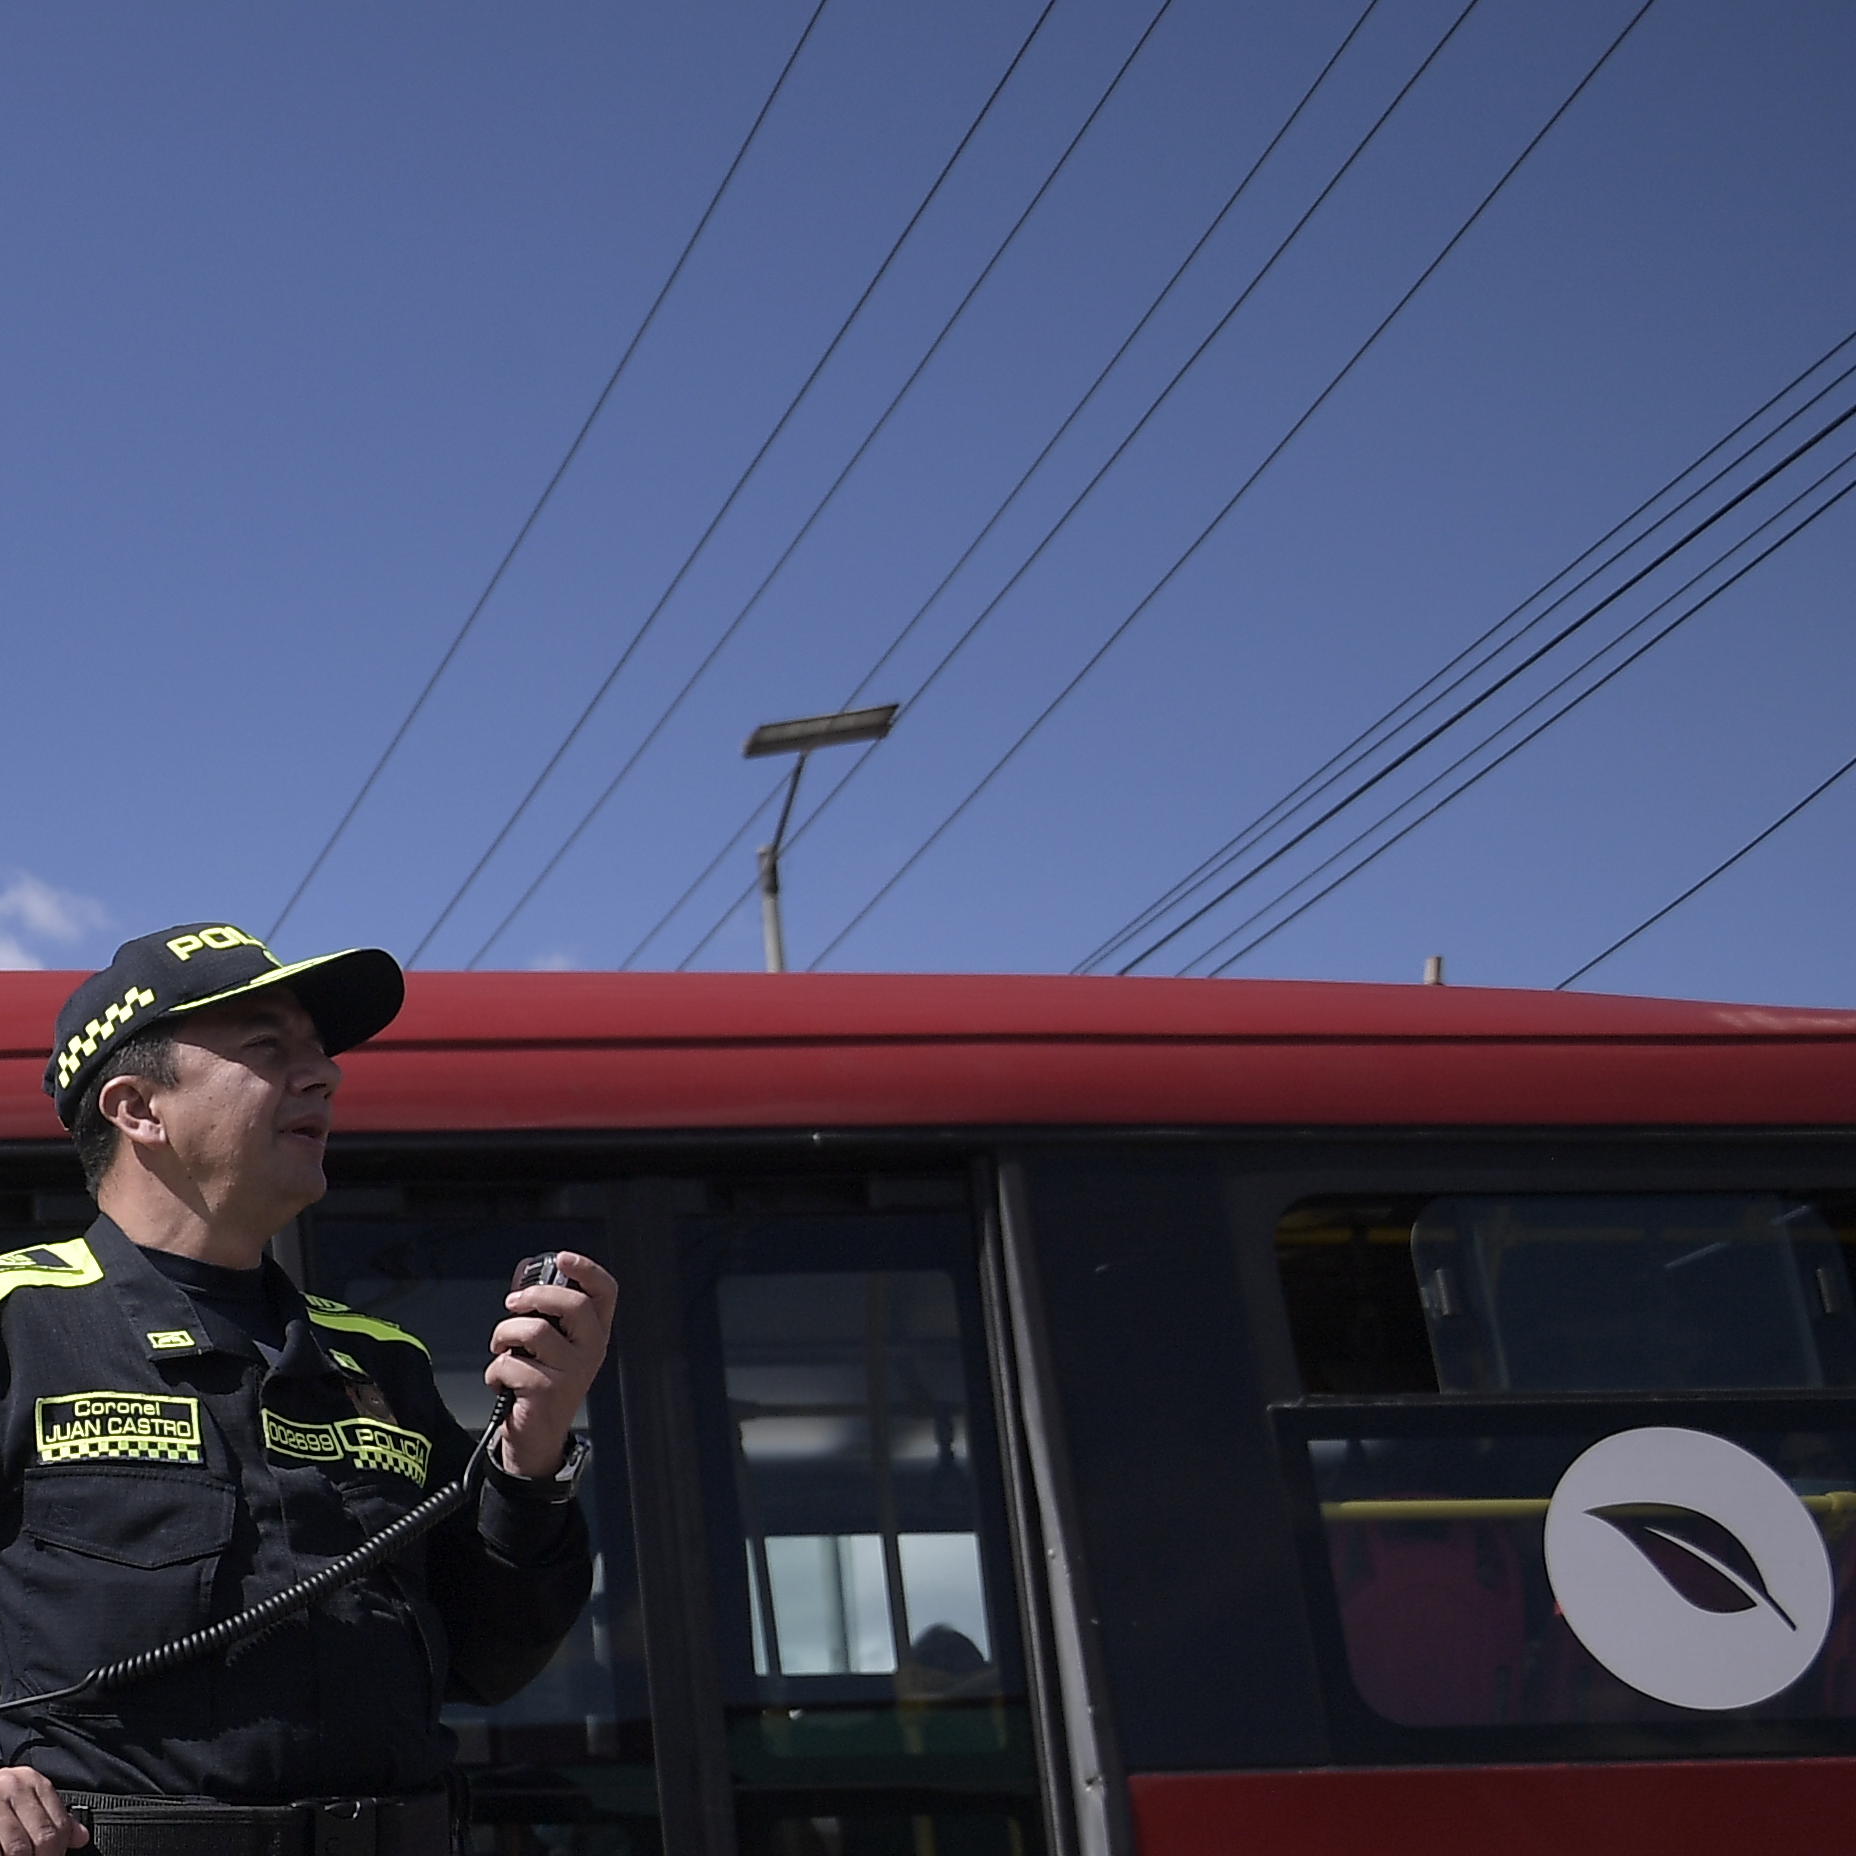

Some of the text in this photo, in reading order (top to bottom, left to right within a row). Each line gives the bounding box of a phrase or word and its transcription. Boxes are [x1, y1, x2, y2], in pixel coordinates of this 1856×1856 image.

[74, 1400, 161, 1417] Coronel
[45, 1417, 192, 1443] JUAN CASTRO
[268, 1421, 335, 1452] 002699
[355, 1428, 424, 1467] POLICÍA
